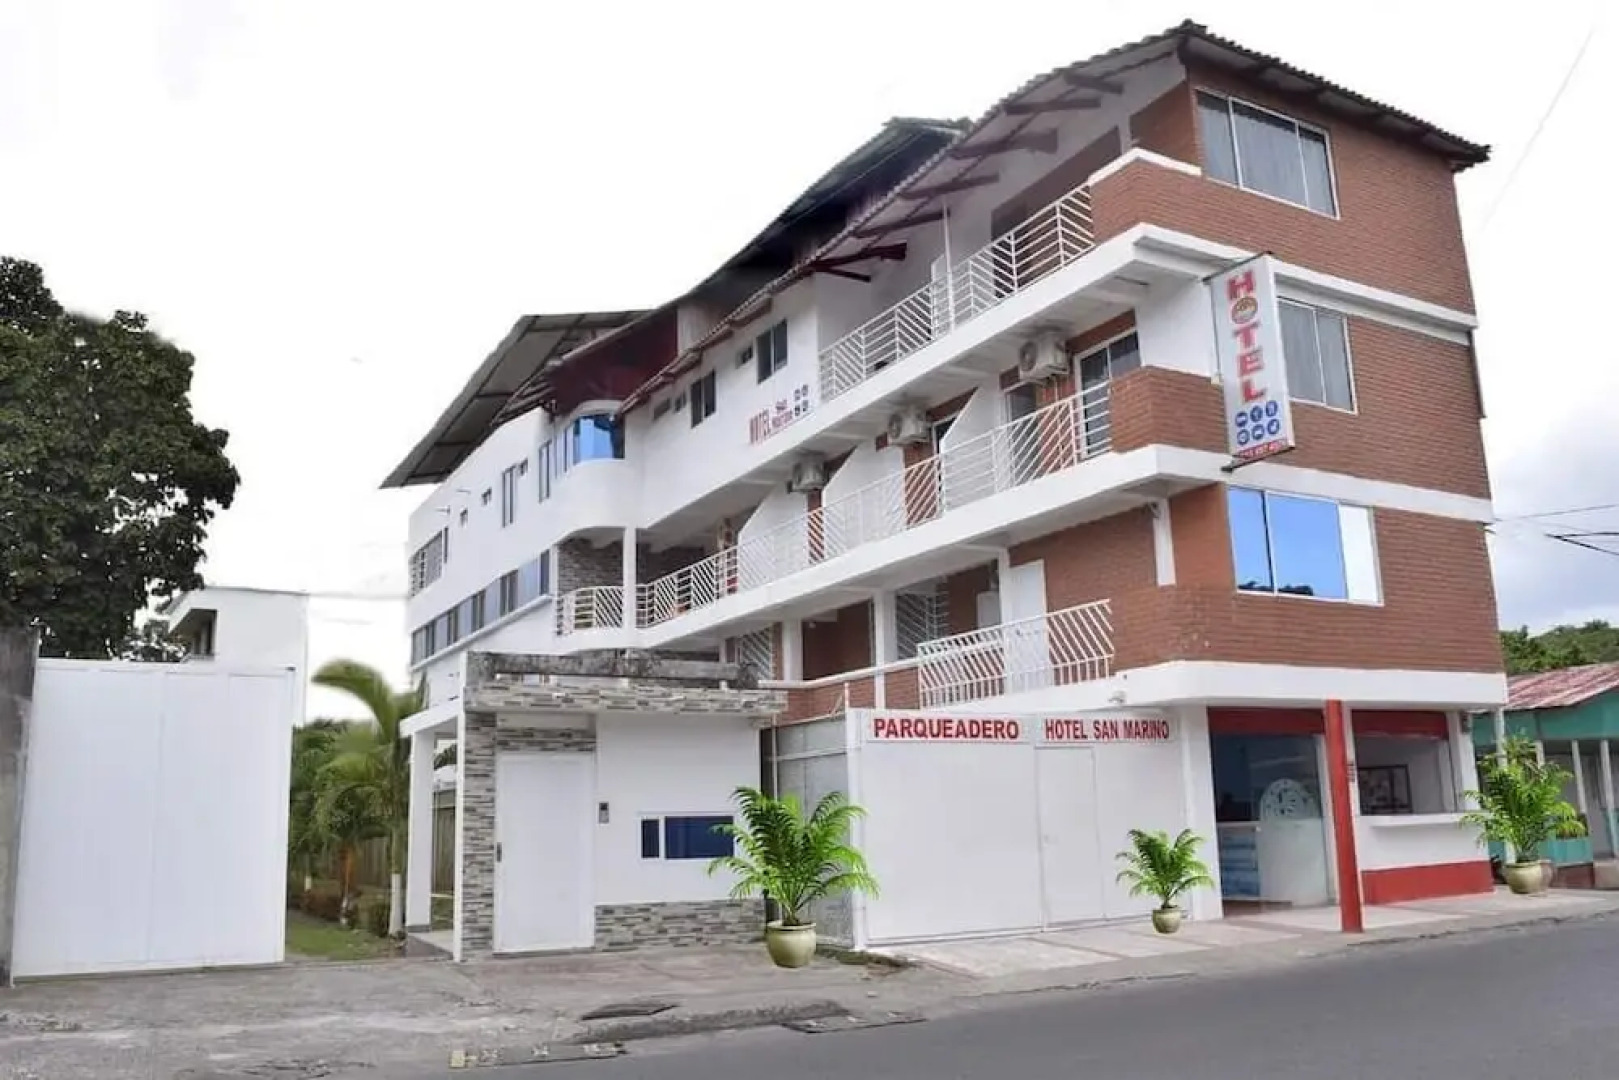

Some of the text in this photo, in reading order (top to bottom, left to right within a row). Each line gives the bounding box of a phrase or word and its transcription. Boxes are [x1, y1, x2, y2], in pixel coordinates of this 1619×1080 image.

[1226, 270, 1267, 402] HOTEL
[873, 718, 1020, 739] PARQUEADERO
[1045, 719, 1170, 739] HOTEL SAN MARINO
